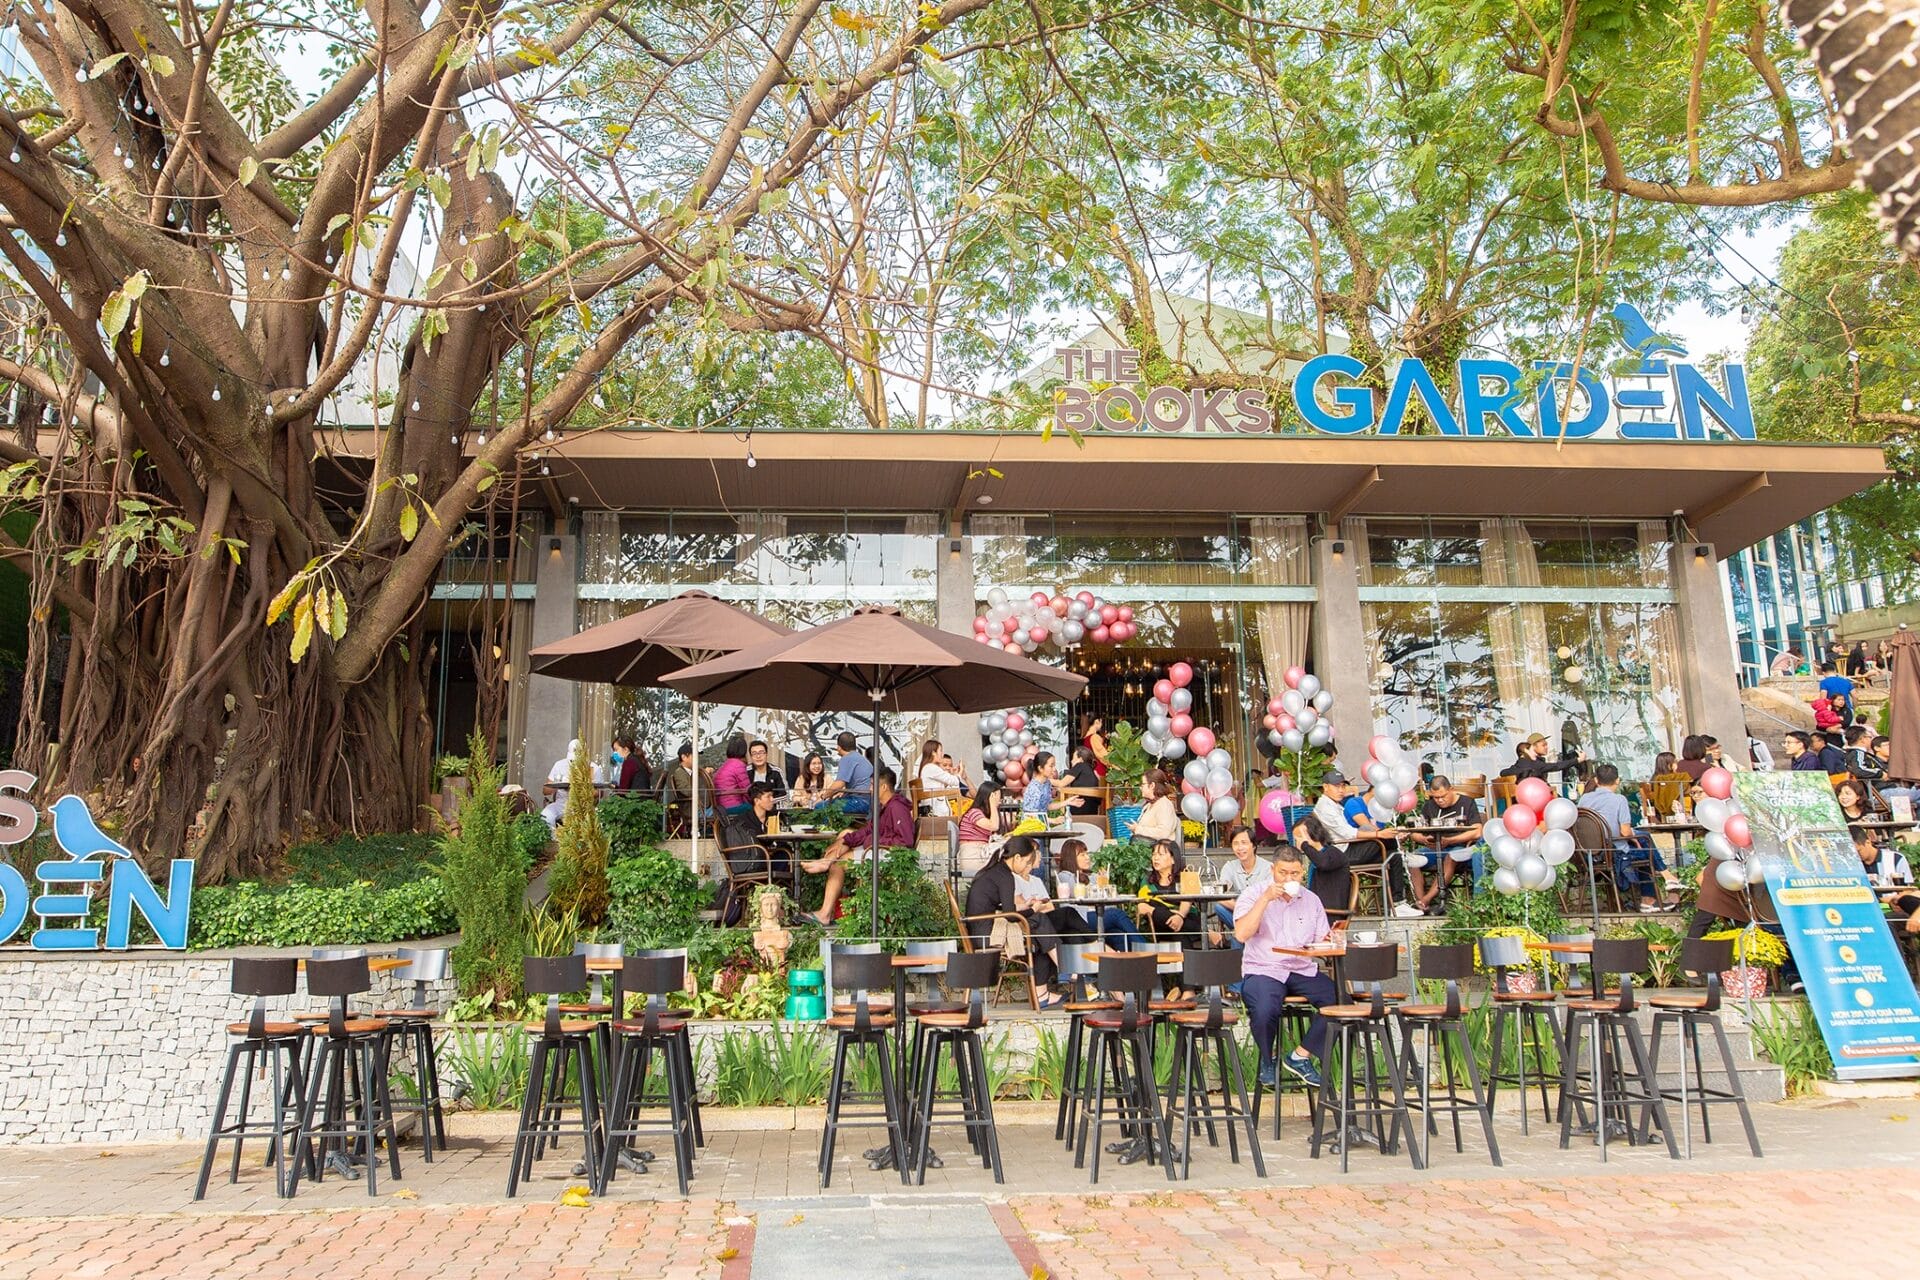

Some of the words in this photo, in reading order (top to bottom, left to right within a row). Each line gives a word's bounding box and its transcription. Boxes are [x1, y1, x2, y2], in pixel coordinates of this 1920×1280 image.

[1055, 348, 1139, 382] THE
[1055, 387, 1271, 434] BOOKS
[1292, 353, 1756, 441] GARDEN
[1790, 878, 1861, 888] anniversary
[1864, 973, 1887, 983] 10%
